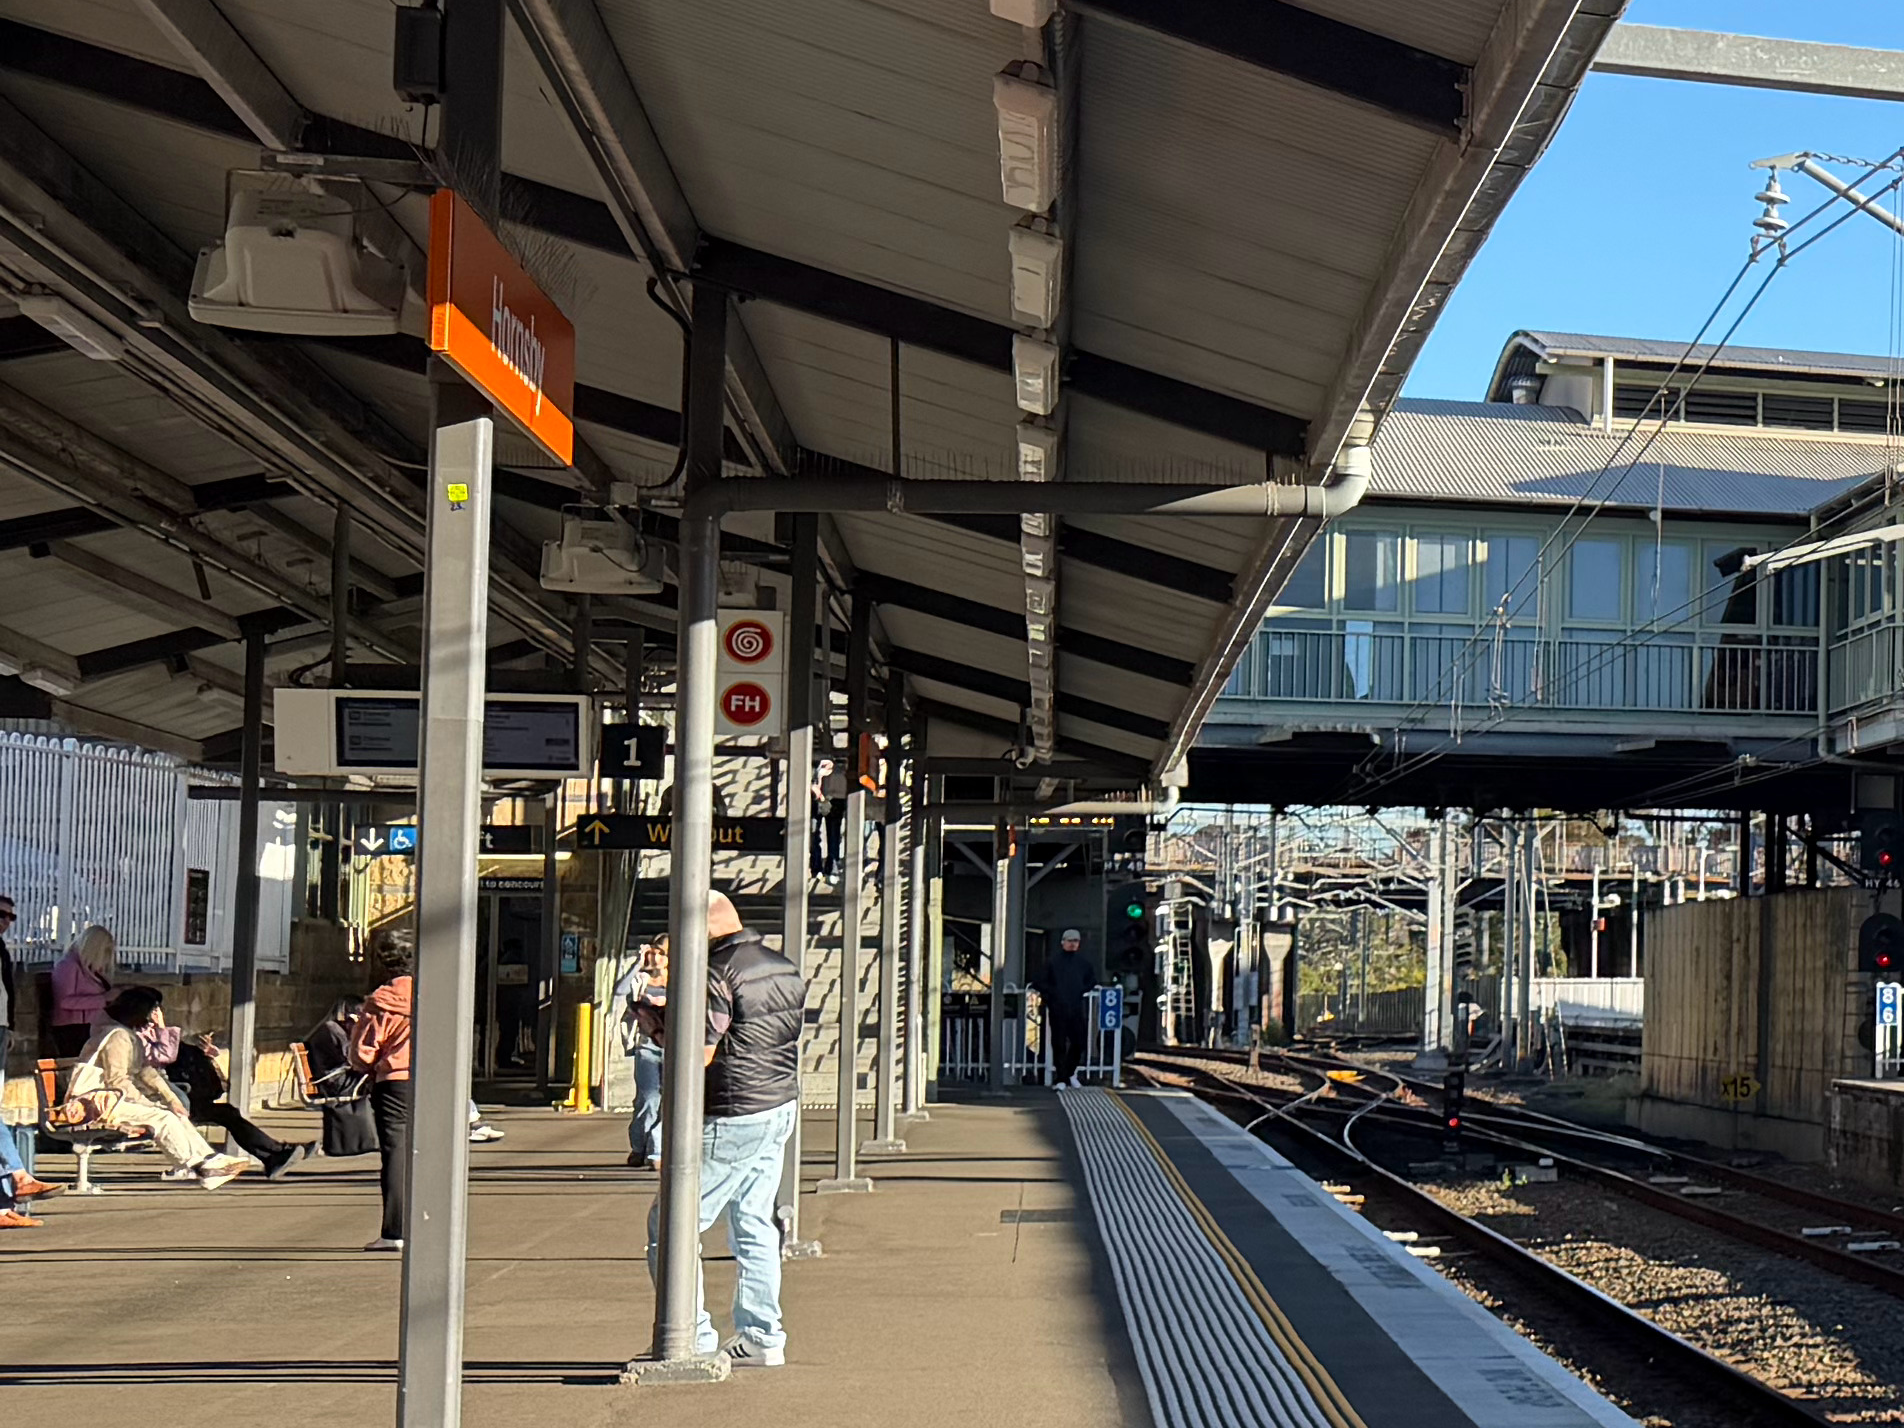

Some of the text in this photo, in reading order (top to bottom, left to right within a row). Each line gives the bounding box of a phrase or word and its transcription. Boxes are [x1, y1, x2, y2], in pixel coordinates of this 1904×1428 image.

[492, 275, 545, 416] Hornsby
[730, 695, 761, 713] FH
[623, 737, 642, 767] 1
[711, 825, 744, 843] ut
[1105, 991, 1117, 1007] 8
[1882, 988, 1894, 1004] 8
[1105, 1010, 1117, 1028] 6
[1882, 1007, 1894, 1023] 6
